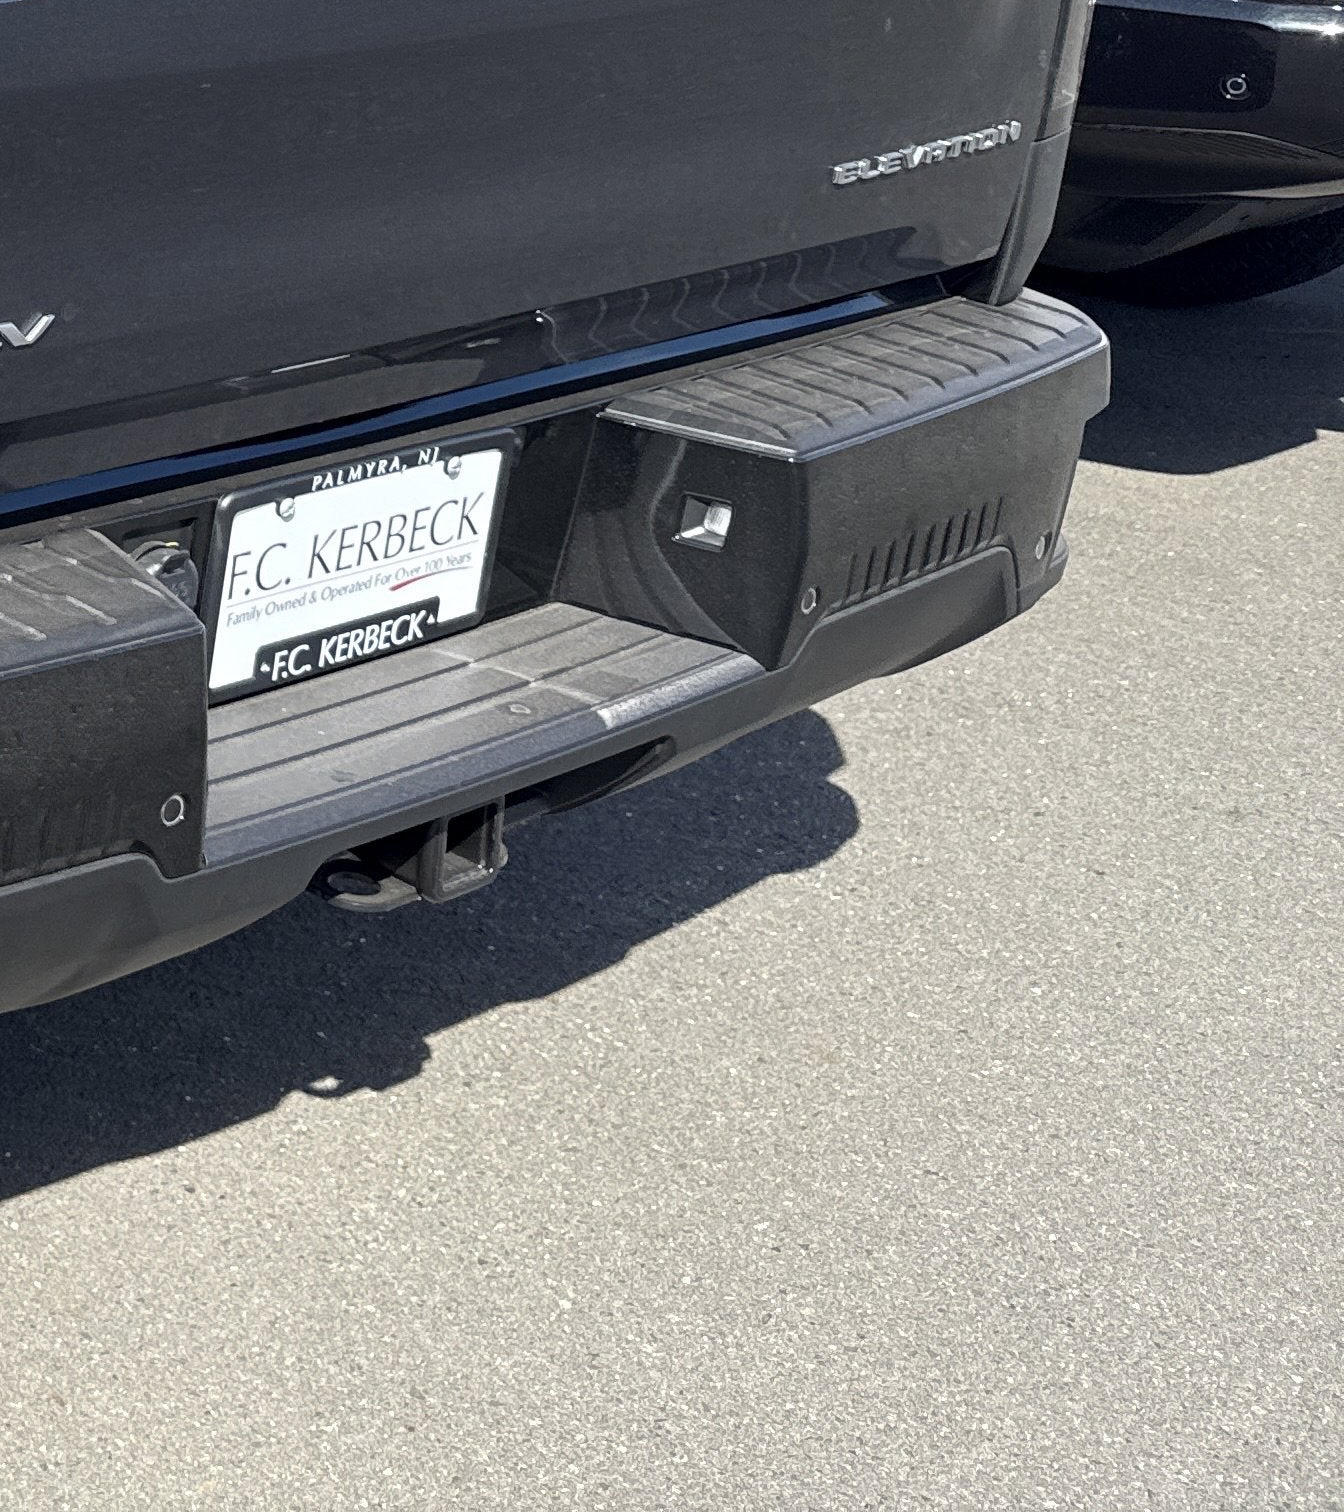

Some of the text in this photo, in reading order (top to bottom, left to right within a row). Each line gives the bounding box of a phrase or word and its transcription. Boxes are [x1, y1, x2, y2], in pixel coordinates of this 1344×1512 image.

[831, 120, 1022, 185] ELEVATION
[312, 455, 408, 491] PALMYRA,
[228, 492, 484, 600] F.C. KERBECK
[227, 552, 472, 627] Family Owned & Operated For Over 100 Years
[271, 609, 427, 681] F.C. KERBECK
